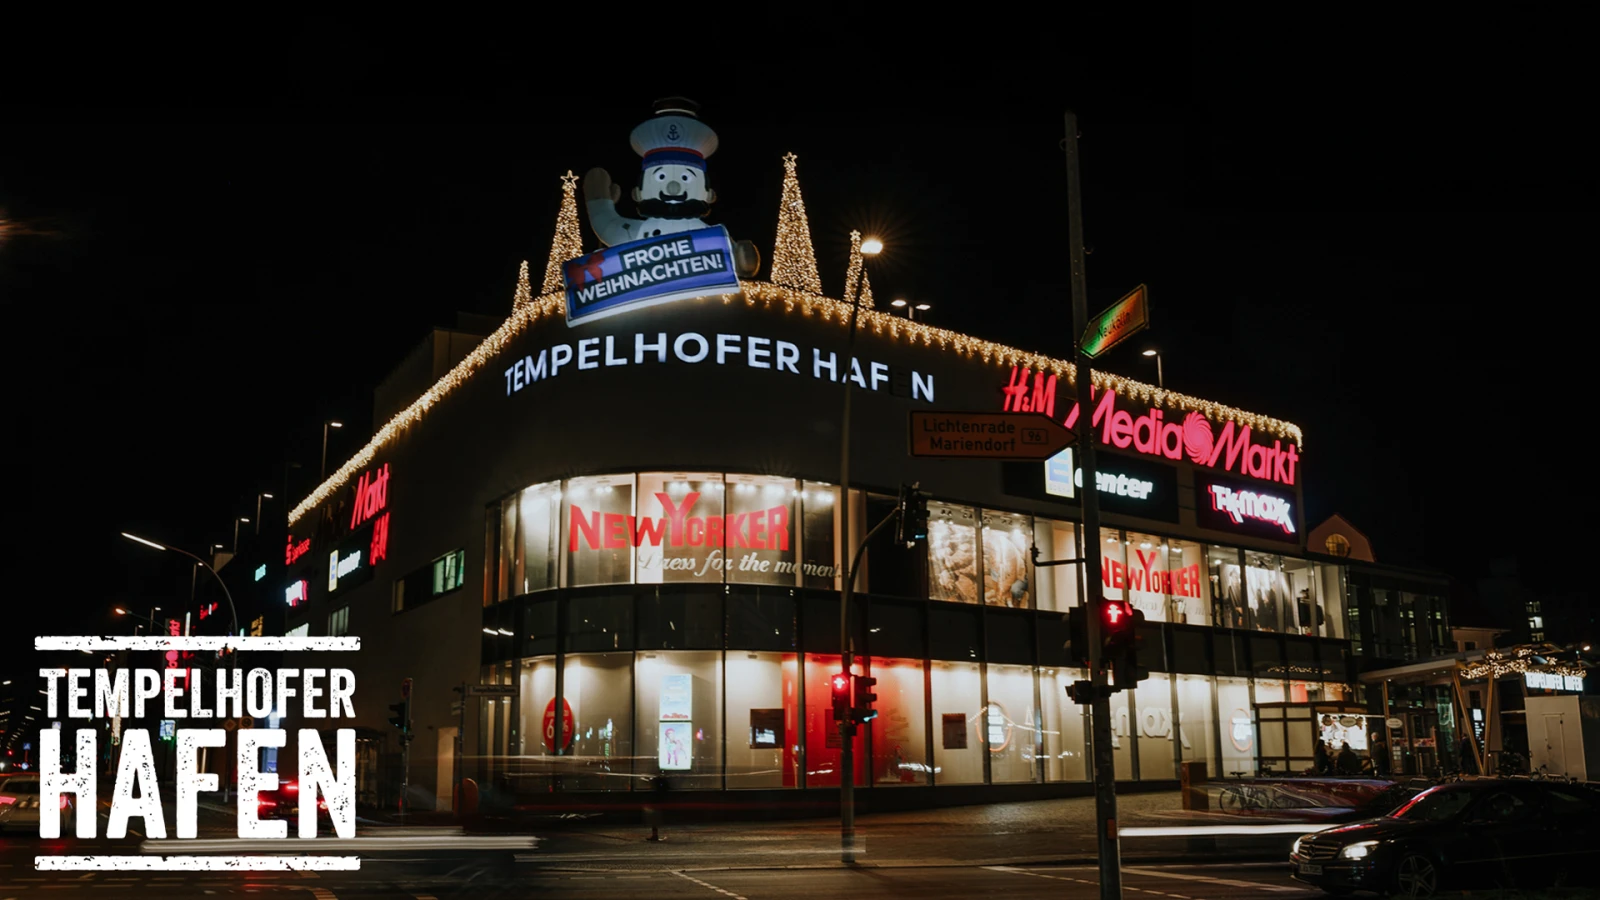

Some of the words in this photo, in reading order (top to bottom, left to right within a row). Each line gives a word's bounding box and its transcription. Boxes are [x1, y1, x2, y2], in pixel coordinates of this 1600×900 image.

[623, 239, 692, 269] FROHE
[577, 253, 723, 303] WEIHNACHTEN!
[504, 332, 800, 396] TEMPELHOFER
[1001, 366, 1057, 418] H&M
[923, 418, 1016, 433] Lichtenrade
[1028, 430, 1042, 442] 96
[929, 436, 1016, 452] Mariendorf
[1208, 420, 1299, 485] Markt
[638, 552, 697, 571] Dress
[694, 549, 734, 577] for
[738, 552, 770, 572] the
